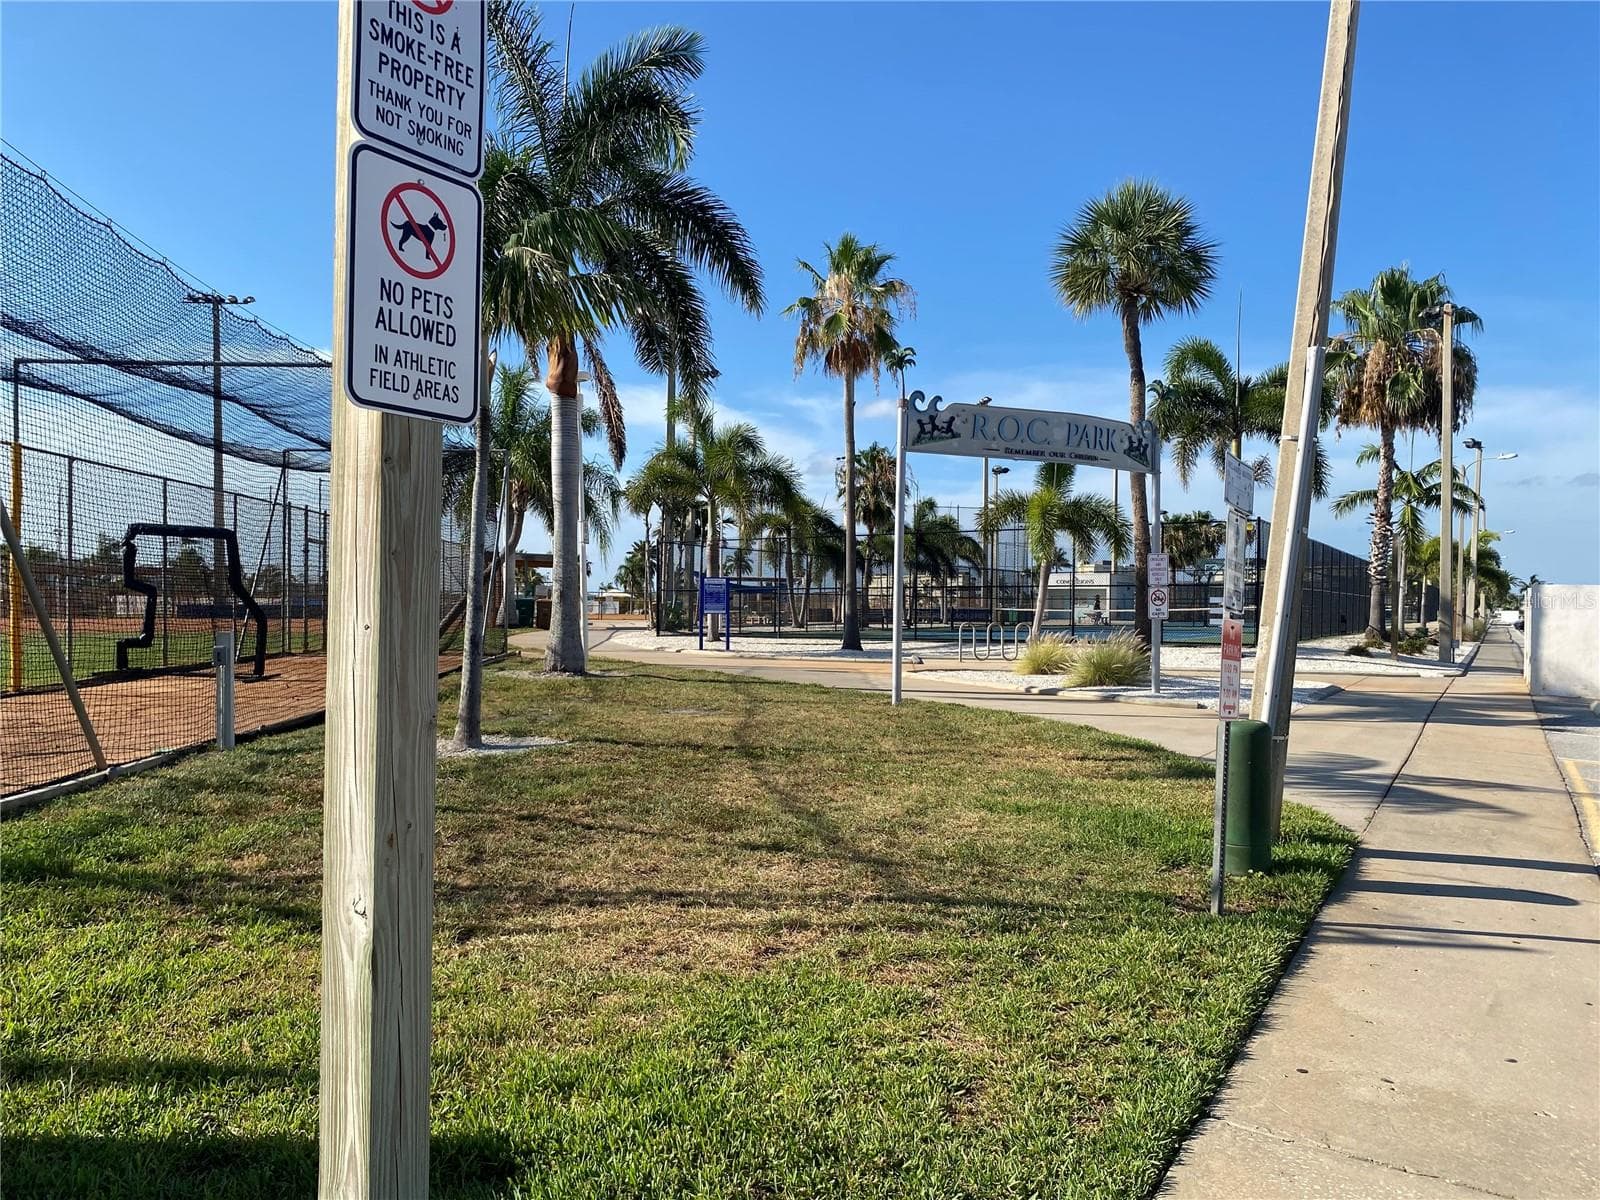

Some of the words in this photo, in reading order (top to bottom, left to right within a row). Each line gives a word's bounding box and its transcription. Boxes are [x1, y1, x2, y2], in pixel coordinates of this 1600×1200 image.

[388, 0, 424, 34] THIS
[430, 19, 445, 45] IS
[450, 30, 462, 55] A
[368, 17, 475, 89] SMOKE-FREE
[378, 51, 466, 111] PROPERTY
[367, 78, 412, 114] THANK
[417, 100, 443, 127] YOU
[447, 115, 472, 140] FOR
[375, 104, 403, 130] NOT
[407, 119, 464, 157] SMOKING
[380, 276, 404, 306] NO
[411, 286, 454, 320] PETS
[374, 306, 457, 348] ALLOWED
[374, 343, 389, 365] IN
[393, 349, 457, 380] ATHLETIC
[369, 367, 410, 394] FIELD
[414, 377, 460, 404] AREAS
[972, 411, 1050, 446] R.O.C.
[1066, 422, 1118, 453] PARK
[1004, 446, 1046, 457] REMEMBER
[1048, 450, 1066, 459] OUR
[1223, 642, 1241, 658] PARKING
